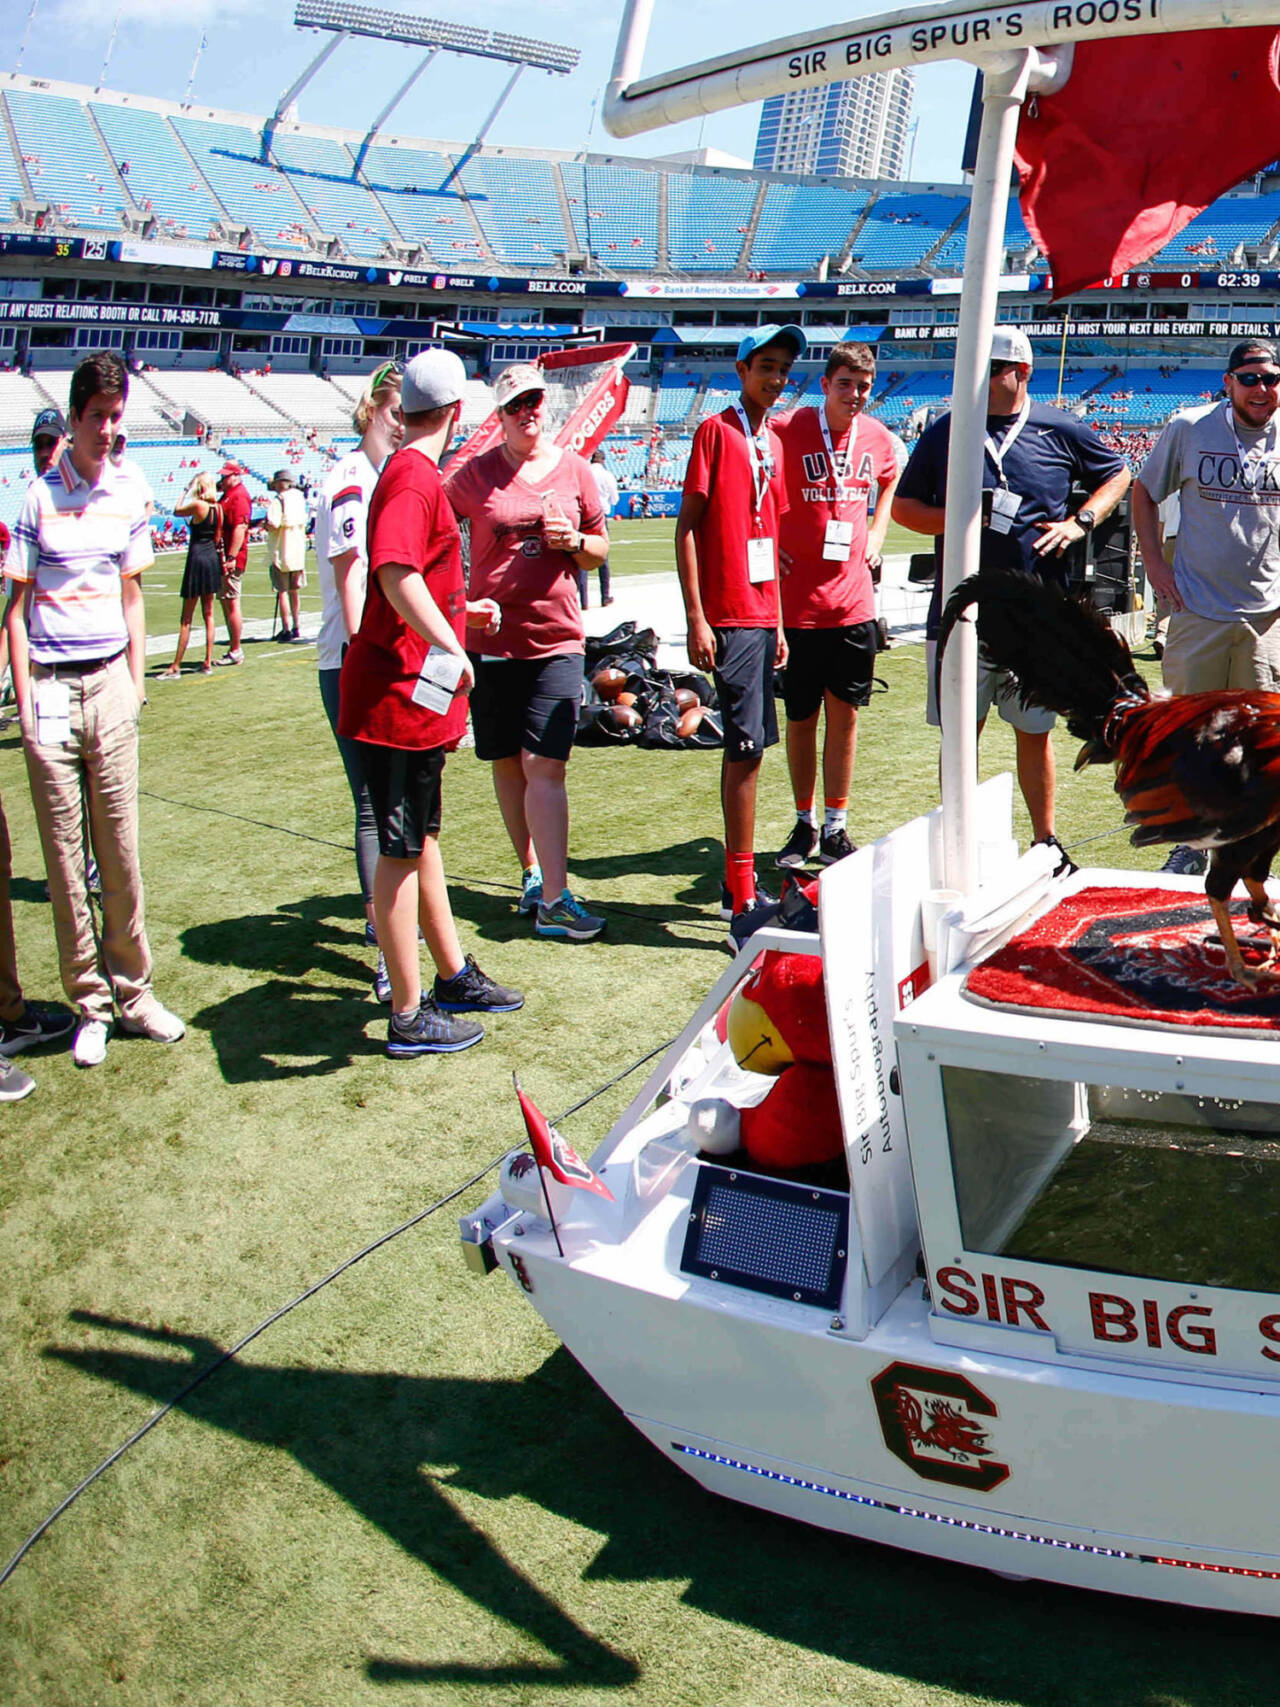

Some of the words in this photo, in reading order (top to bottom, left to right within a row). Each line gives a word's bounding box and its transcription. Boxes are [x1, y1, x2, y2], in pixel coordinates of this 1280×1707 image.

[788, 51, 827, 79] SIR
[845, 34, 892, 65] BIG
[911, 12, 1023, 52] SPUR'S
[1052, 0, 1159, 29] ROOST
[56, 244, 70, 256] 35
[87, 241, 104, 256] 25
[528, 280, 586, 294] BELK.COM
[1181, 274, 1192, 287] 0
[1217, 273, 1260, 288] 62:39
[664, 285, 682, 295] Bank
[694, 285, 727, 295] America
[729, 286, 760, 295] Stadium
[837, 283, 896, 295] BELK.COM
[9, 304, 26, 318] ANY
[27, 304, 55, 318] GUEST
[55, 305, 99, 320] RELATIONS
[99, 307, 127, 321] BOOTH
[128, 308, 140, 321] OR
[141, 308, 161, 322] CALL
[162, 309, 221, 326] 704-358-7170.
[894, 327, 918, 339] BANK
[919, 327, 931, 339] OF
[1077, 323, 1100, 335] HOST
[1102, 323, 1126, 335] YOUR
[1129, 322, 1151, 335] NEXT
[1153, 322, 1170, 335] BIG
[1172, 322, 1204, 335] EVENT!
[1209, 323, 1229, 336] FOR
[1231, 323, 1271, 338] DETAILS,
[802, 452, 873, 482] USA
[843, 997, 862, 1081] Spur's
[865, 971, 894, 1154] Autobiography
[855, 1082, 868, 1127] Big
[861, 1132, 873, 1165] Sir
[935, 1267, 1050, 1332] SIR
[1089, 1292, 1218, 1357] BIG
